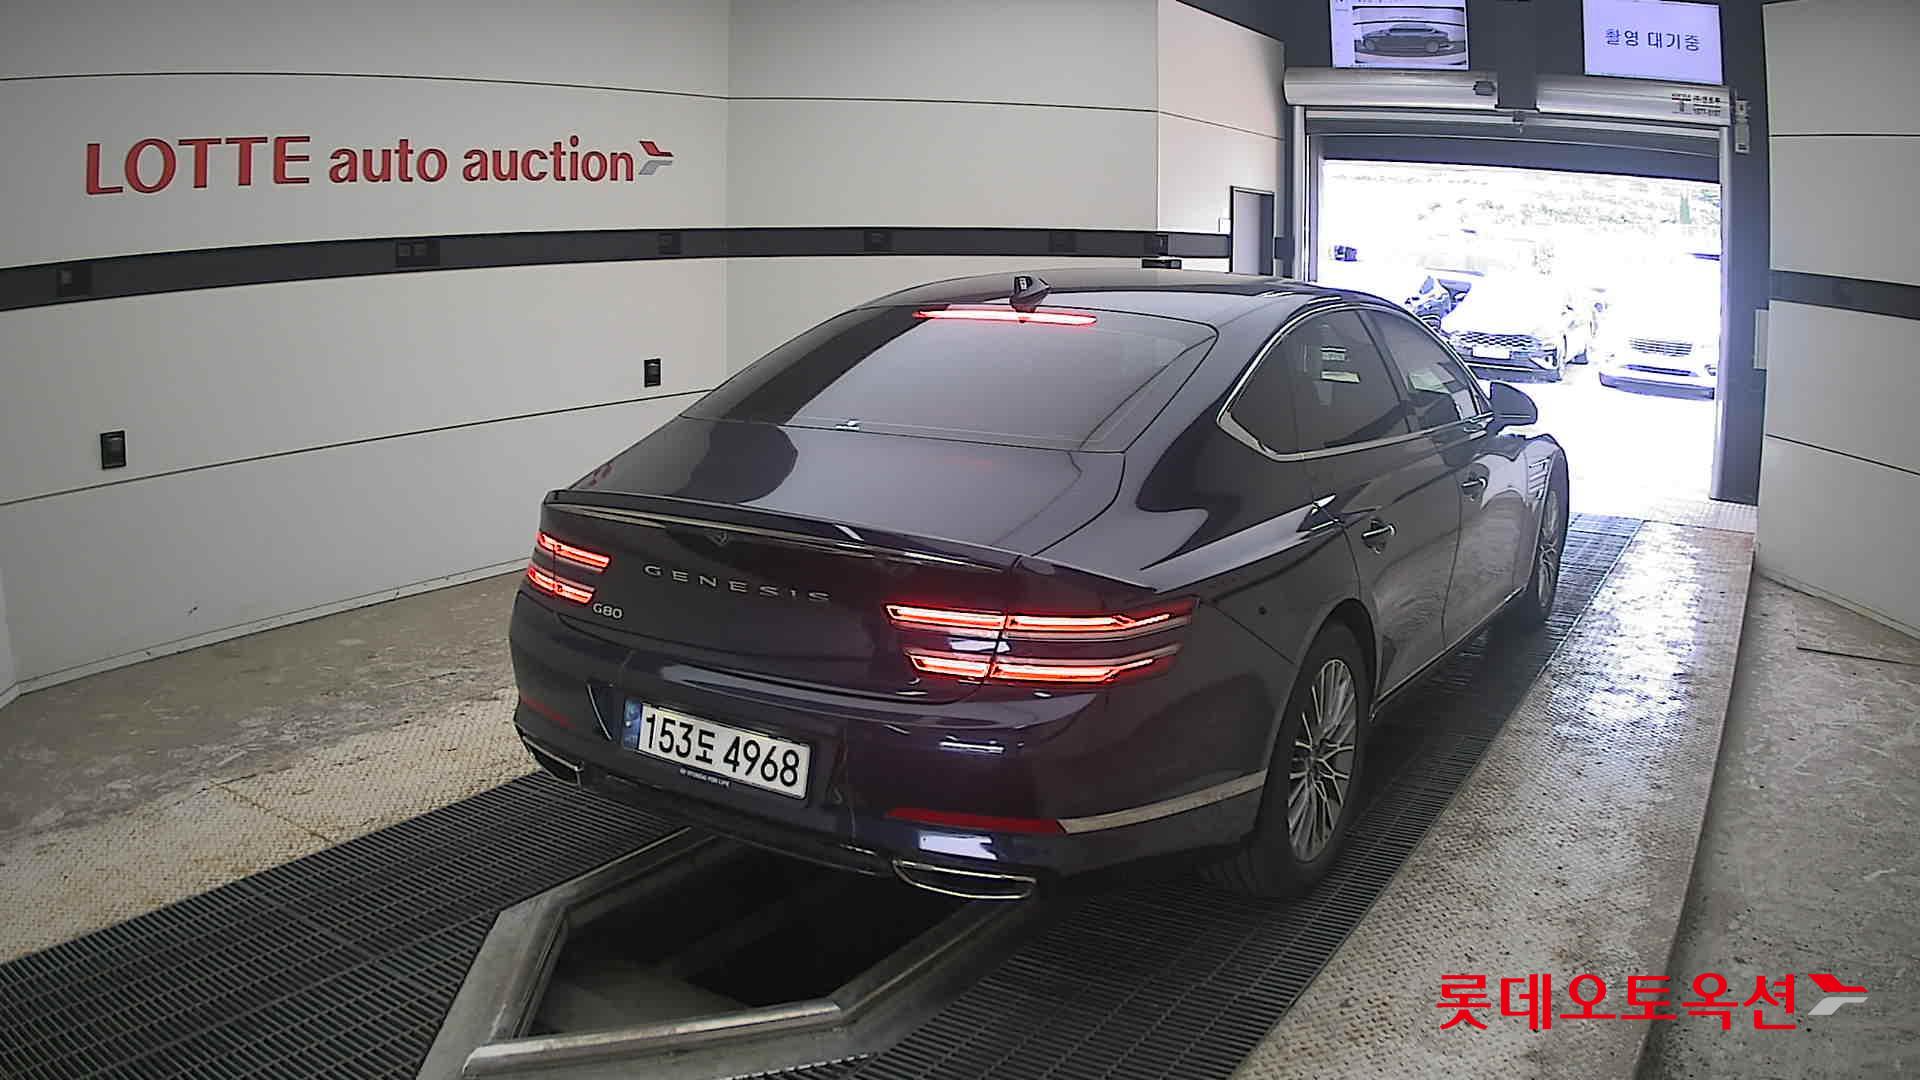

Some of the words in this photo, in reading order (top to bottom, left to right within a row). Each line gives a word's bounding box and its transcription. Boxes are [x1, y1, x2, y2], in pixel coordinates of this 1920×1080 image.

[1647, 31, 1699, 51] 대기중
[85, 135, 311, 195] LOTTE
[328, 138, 448, 184] auto
[462, 135, 635, 183] auction
[643, 565, 830, 602] GENESIS
[592, 602, 624, 619] G80
[646, 713, 716, 765] 153도
[723, 735, 800, 787] 4968
